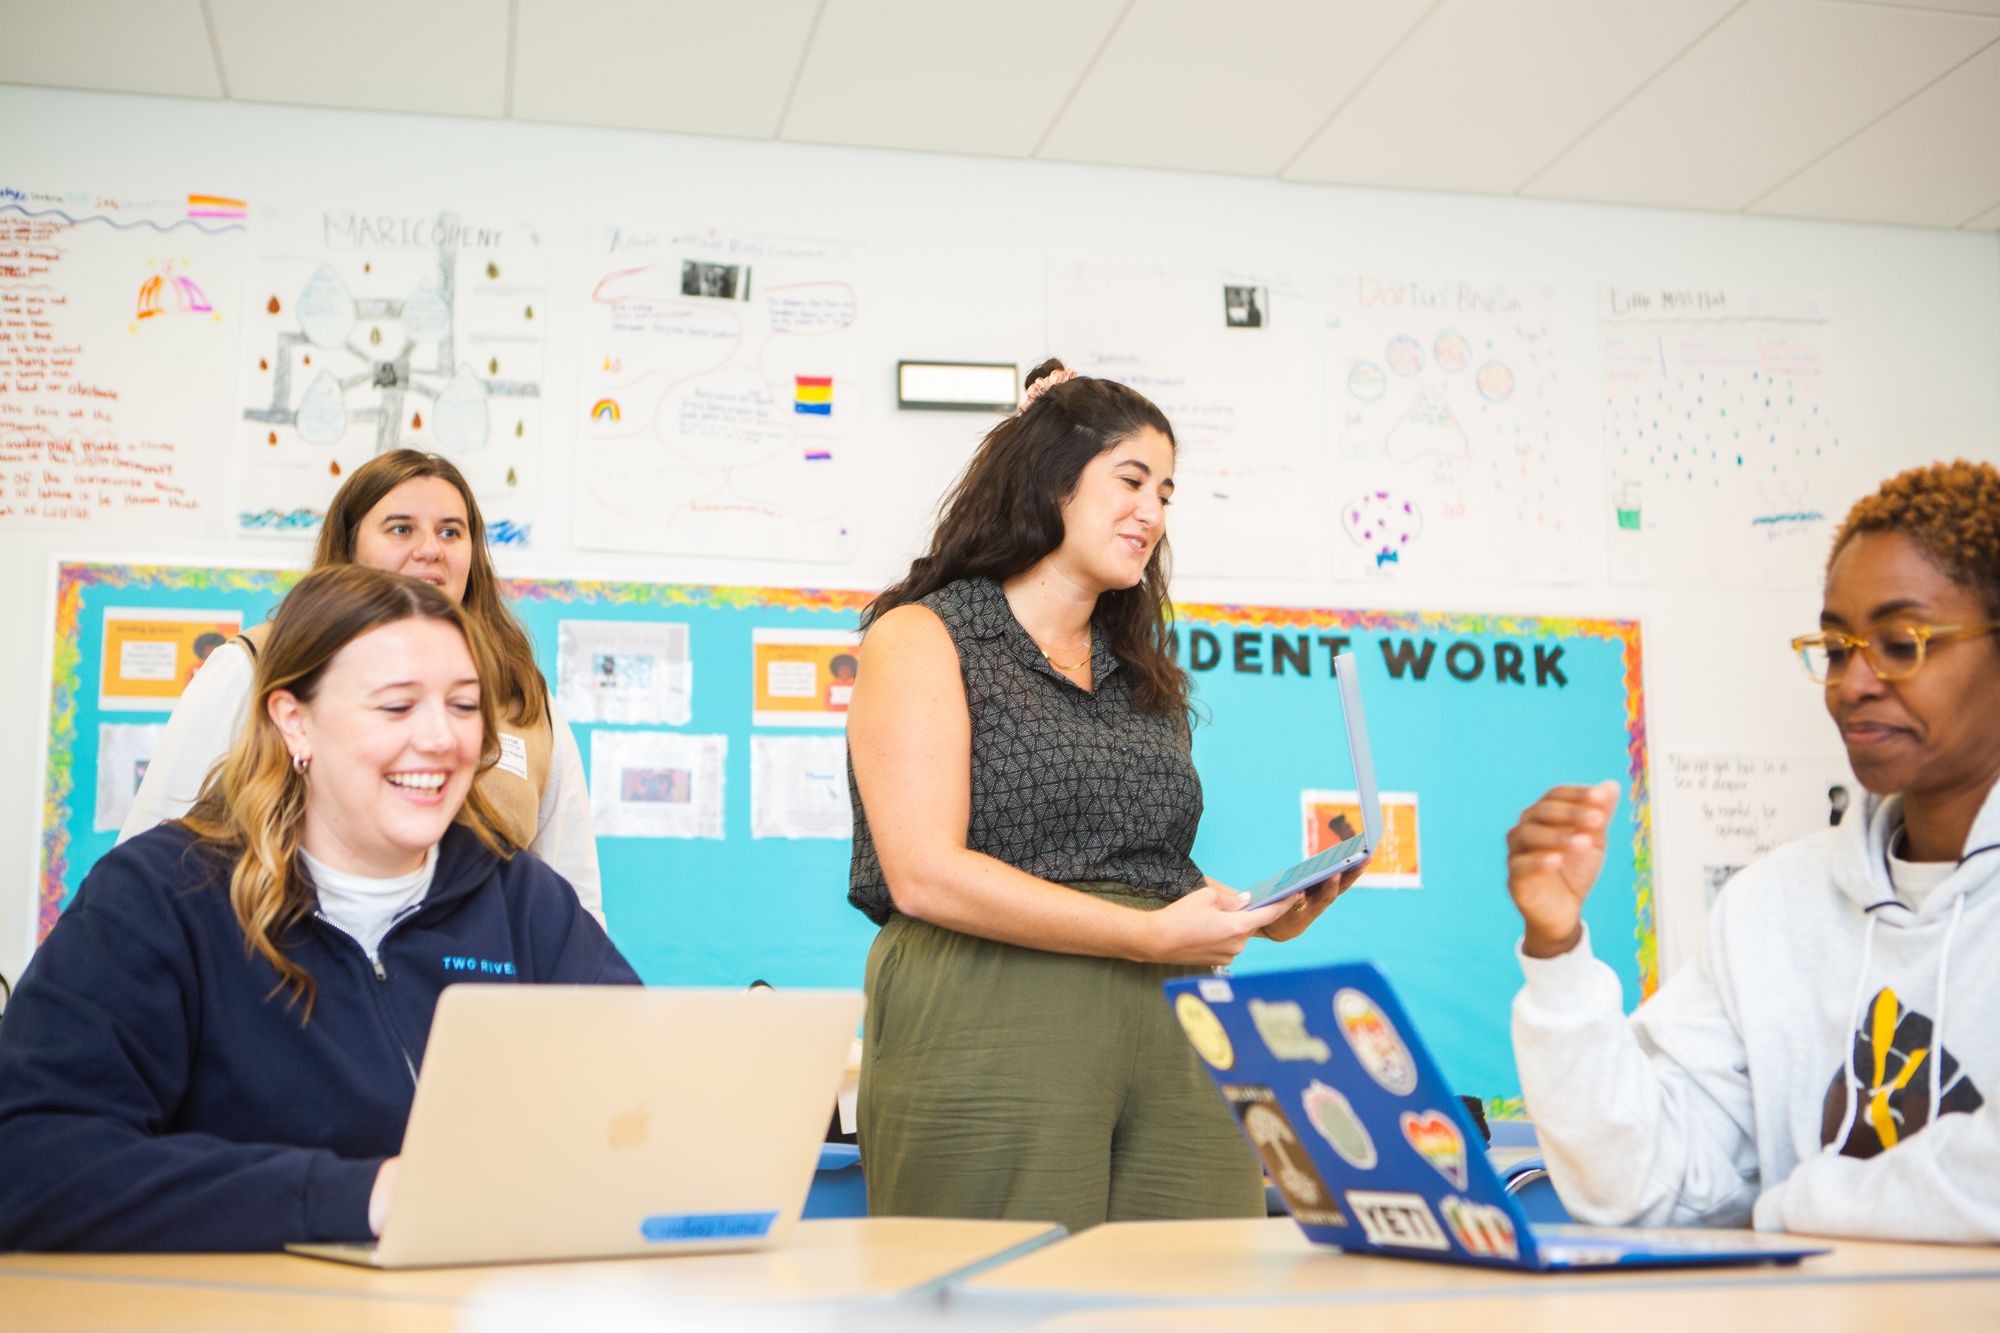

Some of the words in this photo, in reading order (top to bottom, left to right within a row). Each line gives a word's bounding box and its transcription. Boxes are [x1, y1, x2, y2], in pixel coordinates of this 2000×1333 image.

[1379, 636, 1569, 689] WORK
[443, 956, 477, 971] TWO
[1360, 1206, 1439, 1241] YETI
